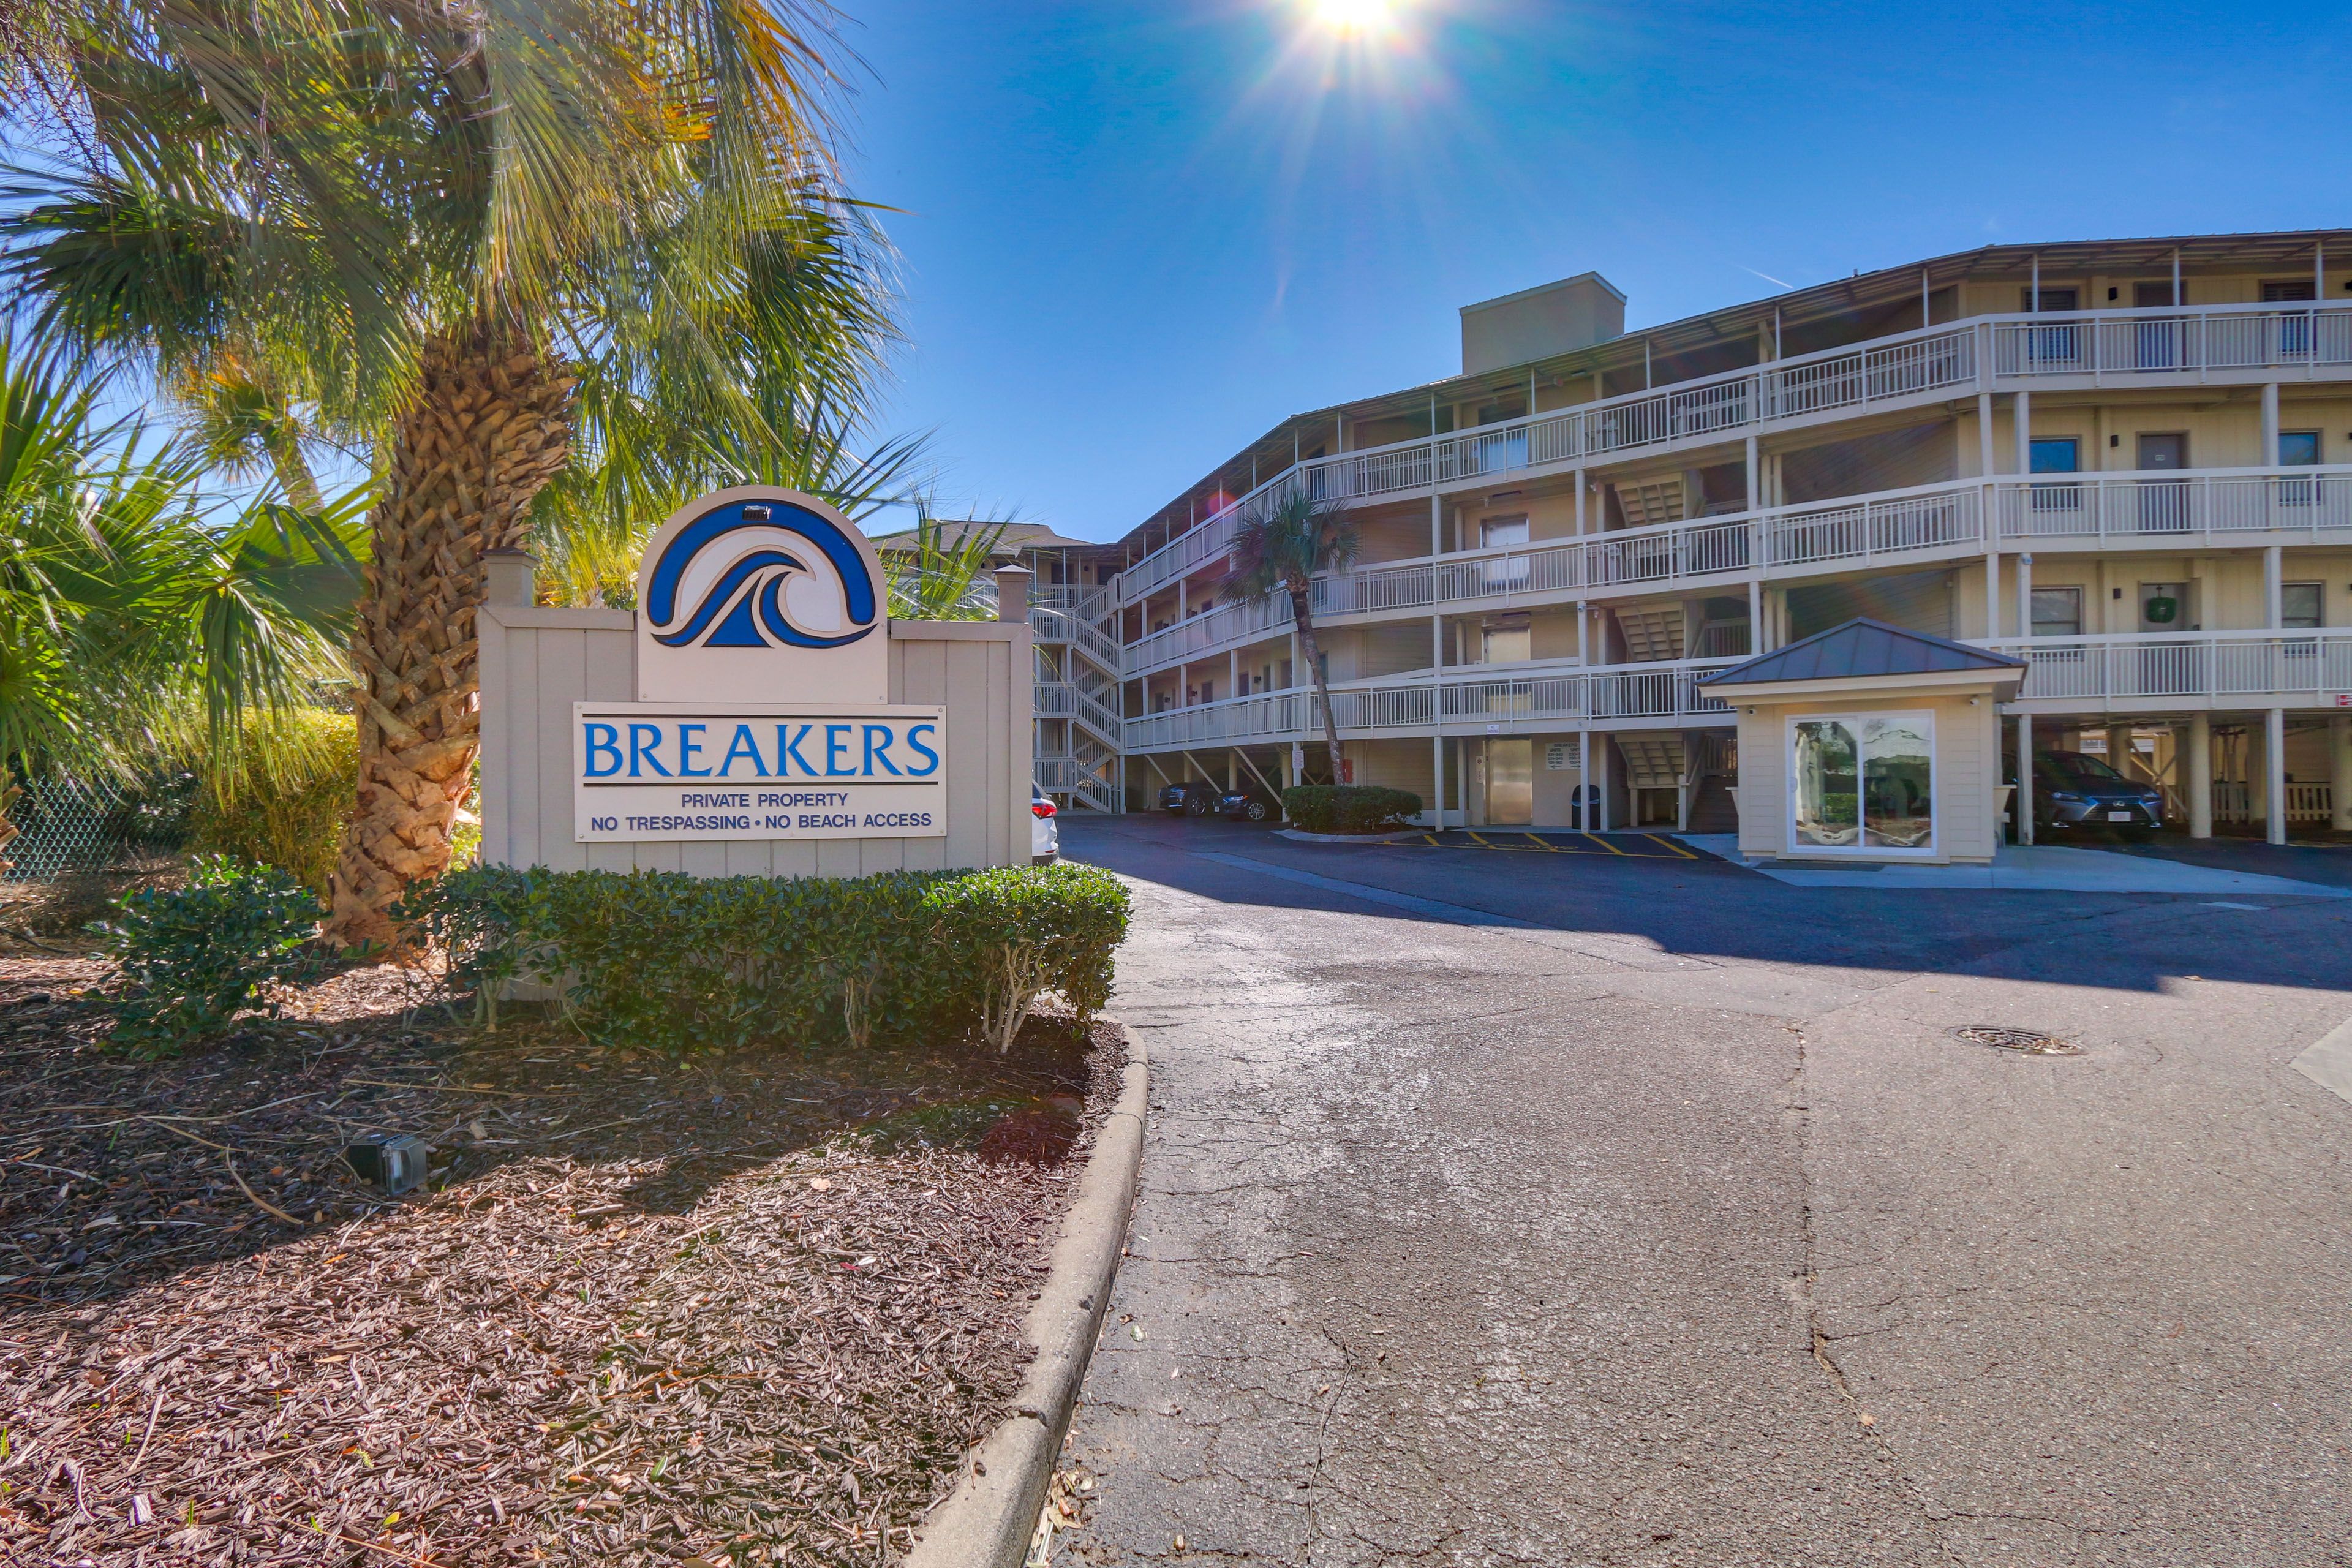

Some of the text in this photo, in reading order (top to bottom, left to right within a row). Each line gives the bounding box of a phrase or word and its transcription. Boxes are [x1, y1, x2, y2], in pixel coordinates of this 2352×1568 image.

[582, 723, 939, 777] BREAKERS
[682, 793, 848, 808] PRIVATE PROPERTY
[591, 813, 932, 831] NO TRESPASSING NO BEACH ACCESS
